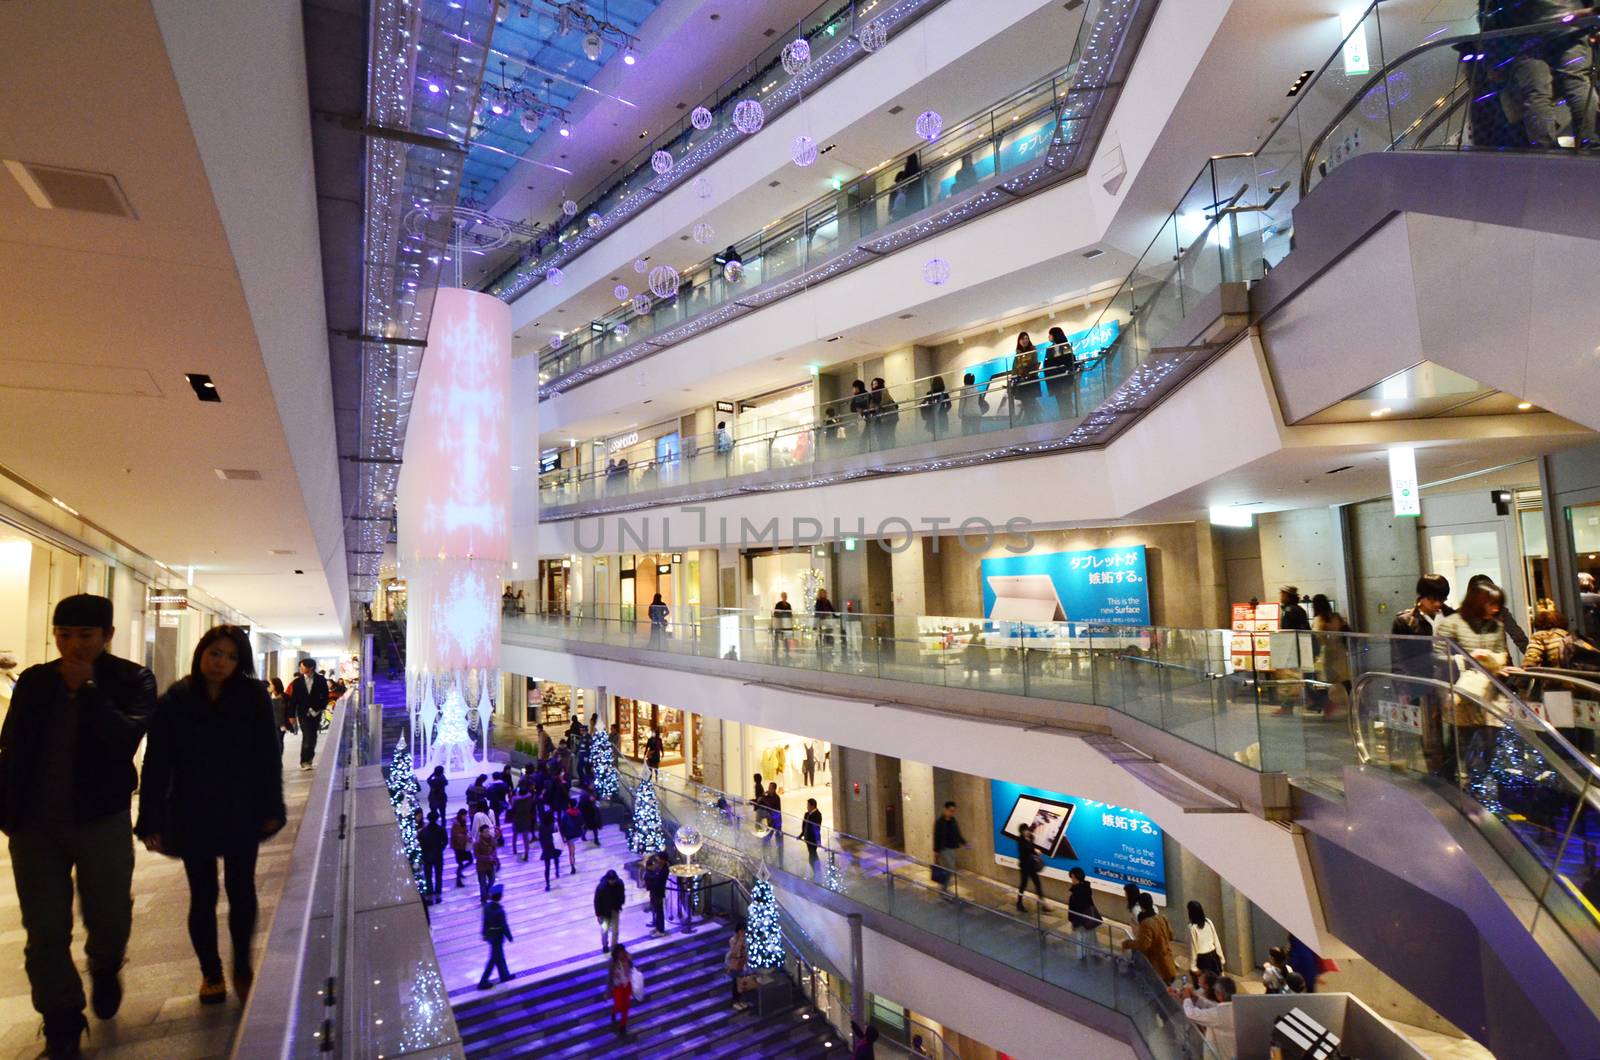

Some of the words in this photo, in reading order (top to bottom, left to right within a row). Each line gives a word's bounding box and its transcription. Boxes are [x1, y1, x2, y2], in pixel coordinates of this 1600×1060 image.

[1071, 552, 1138, 570] タブレットが
[1088, 570, 1143, 584] 嫉妬する。
[1108, 597, 1120, 605] This
[1128, 597, 1140, 605] the
[1114, 605, 1140, 614] Surface
[1102, 812, 1158, 835] 嫉妬する。
[1121, 844, 1135, 854] This
[1142, 848, 1155, 858] the
[1129, 854, 1155, 867] Surface
[1098, 868, 1119, 879] Surface
